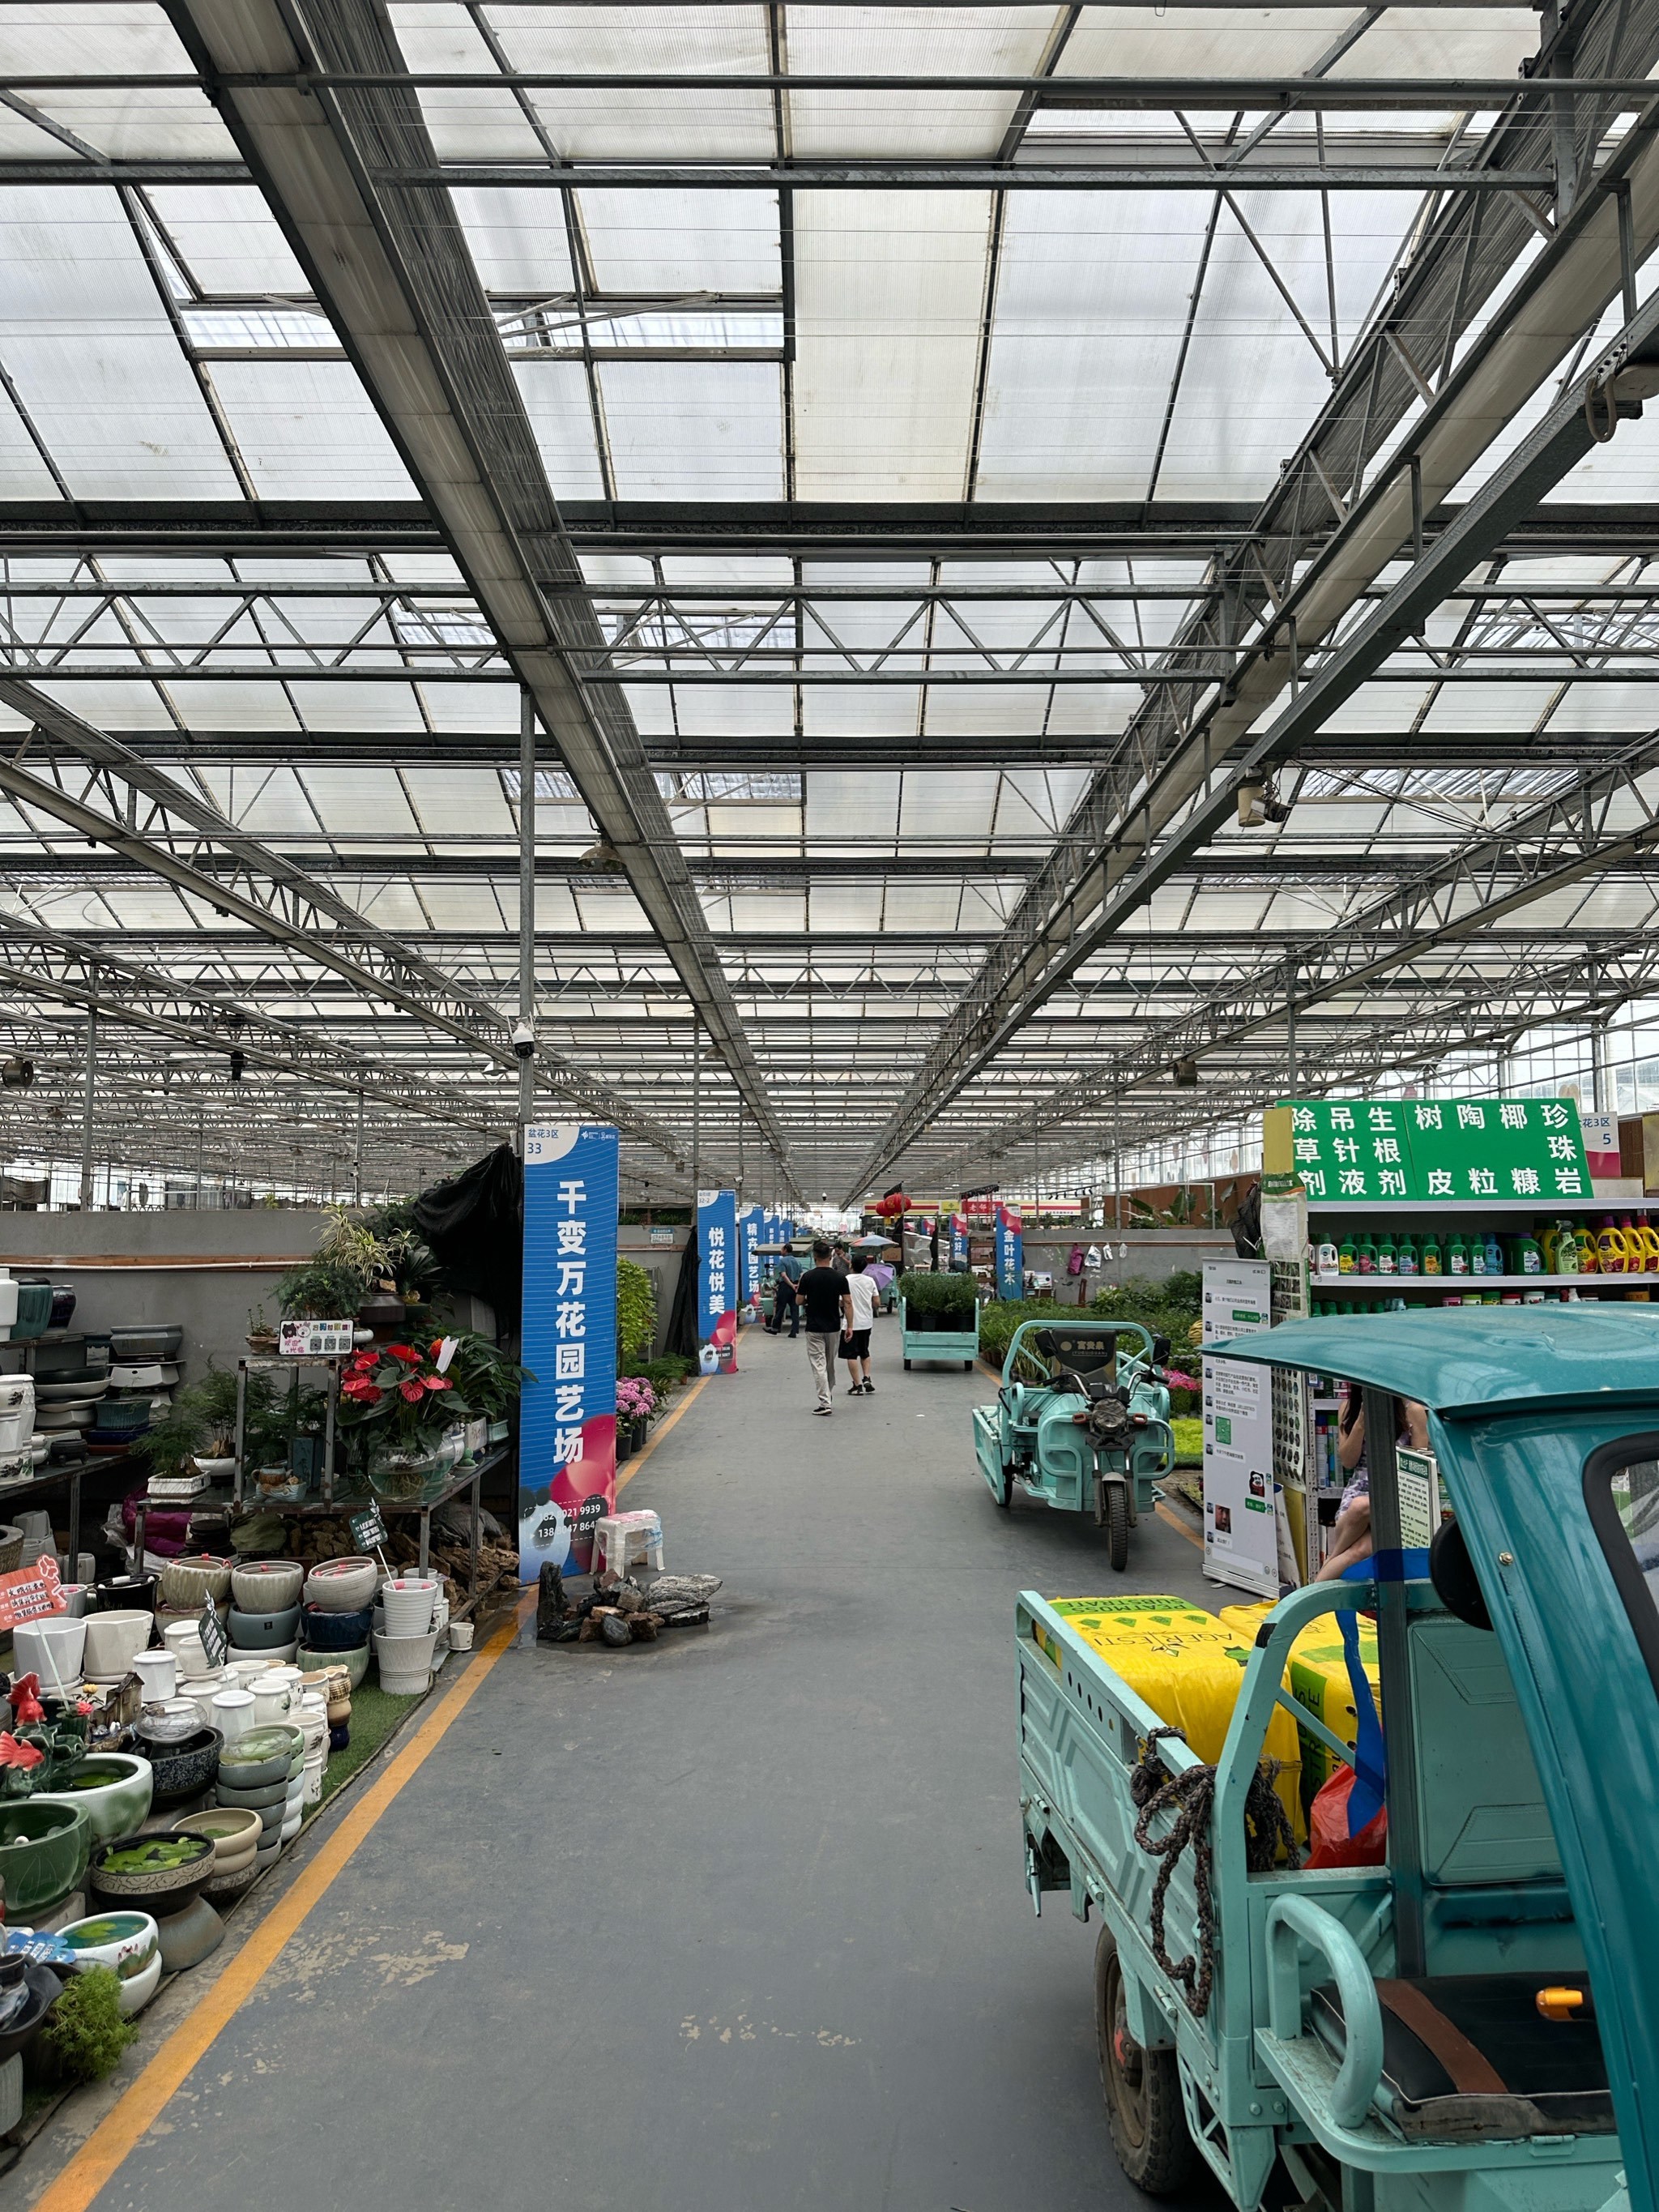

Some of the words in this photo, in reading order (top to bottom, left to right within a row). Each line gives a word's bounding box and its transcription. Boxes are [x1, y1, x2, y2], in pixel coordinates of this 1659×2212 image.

[527, 1128, 559, 1139] 盆花3区
[527, 1142, 542, 1154] 33
[1291, 1106, 1326, 1197] 除草剂
[1329, 1107, 1367, 1196] 吊针液
[1367, 1107, 1409, 1196] 生根剂
[1414, 1104, 1456, 1196] 树皮
[1456, 1104, 1499, 1194] 陶粒
[1499, 1104, 1542, 1194] 椰糠
[1540, 1103, 1583, 1195] 珍珠岩
[1602, 1133, 1611, 1145] 5
[708, 1226, 726, 1315] 悦花悦美
[746, 1223, 760, 1293] 精卉园艺场
[1003, 1229, 1016, 1286] 金叶花木
[553, 1180, 587, 1465] 千变万花园艺场
[538, 1527, 554, 1539] 138
[557, 1524, 578, 1534] 8047
[579, 1504, 600, 1515] 9939
[1062, 1598, 1186, 1608] SUBSTRATE
[1072, 1604, 1187, 1613] PEATMOSS
